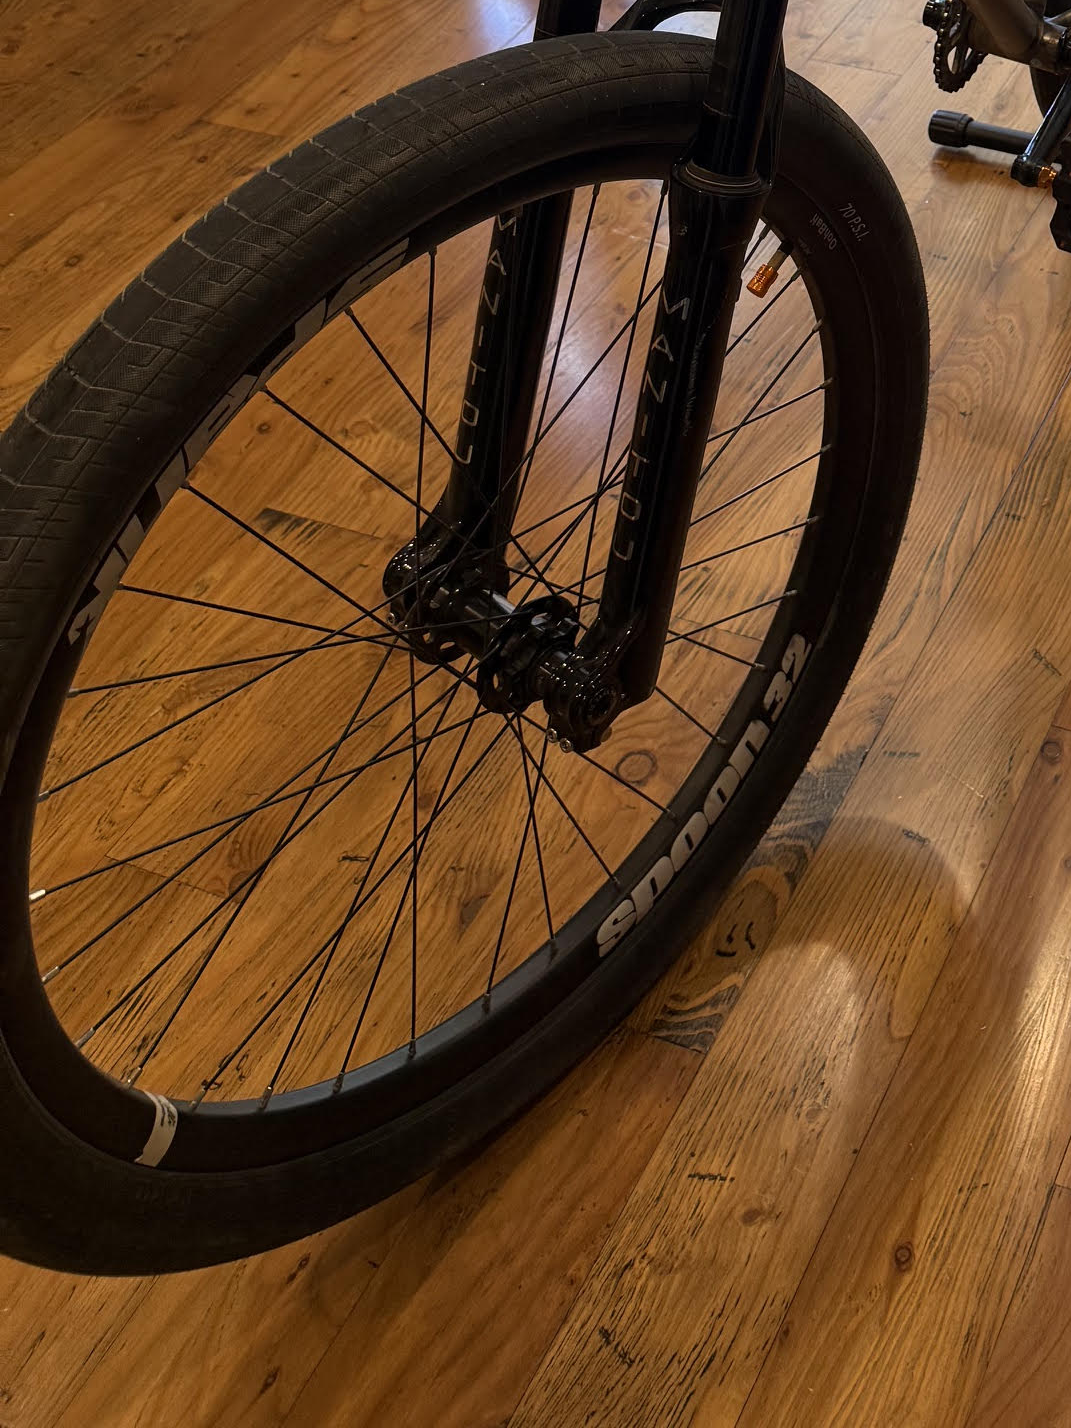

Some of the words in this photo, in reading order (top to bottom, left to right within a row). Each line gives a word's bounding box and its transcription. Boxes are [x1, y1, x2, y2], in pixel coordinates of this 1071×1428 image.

[457, 210, 517, 465] MANITOU
[838, 202, 857, 219] 70
[613, 285, 690, 561] MANITOU
[596, 718, 770, 958] spoon
[763, 632, 812, 723] 32
